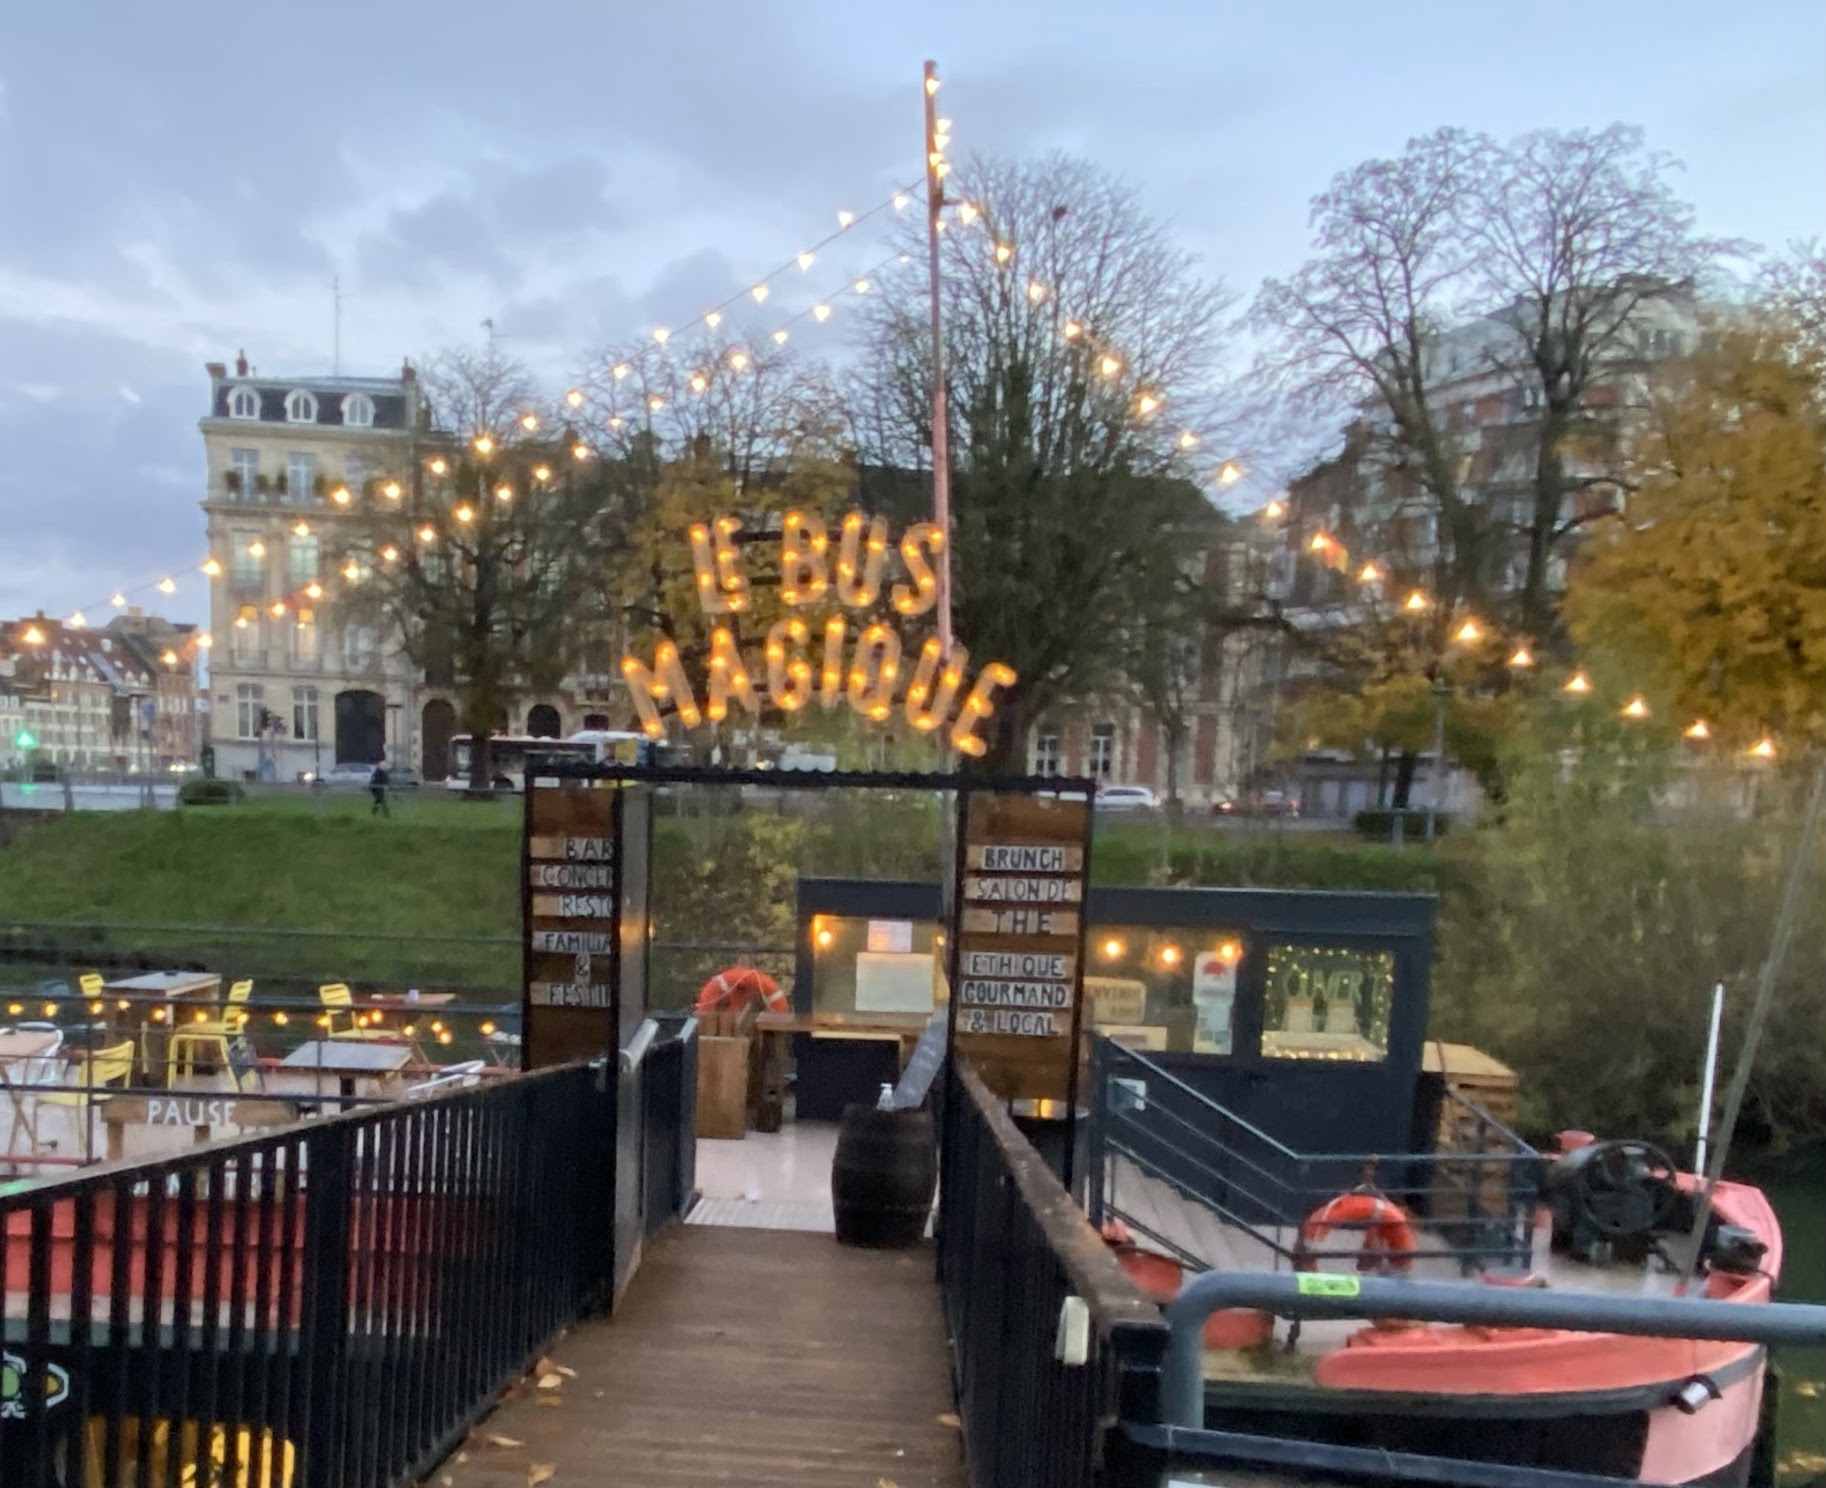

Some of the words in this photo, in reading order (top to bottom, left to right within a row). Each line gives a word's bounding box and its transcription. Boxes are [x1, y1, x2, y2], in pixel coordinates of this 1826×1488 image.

[690, 514, 751, 613] LE
[781, 509, 946, 615] BUS
[621, 613, 1017, 758] MAGIQUE
[565, 838, 614, 860] BAR
[984, 847, 1063, 870] BRUNCH
[976, 878, 1040, 901] SALON
[1048, 880, 1069, 901] DE
[991, 910, 1052, 934] THE
[965, 981, 1067, 1006] GOURMAND
[970, 1010, 985, 1032] &
[997, 1012, 1059, 1036] LOCAL
[147, 1099, 237, 1127] PAUSE
